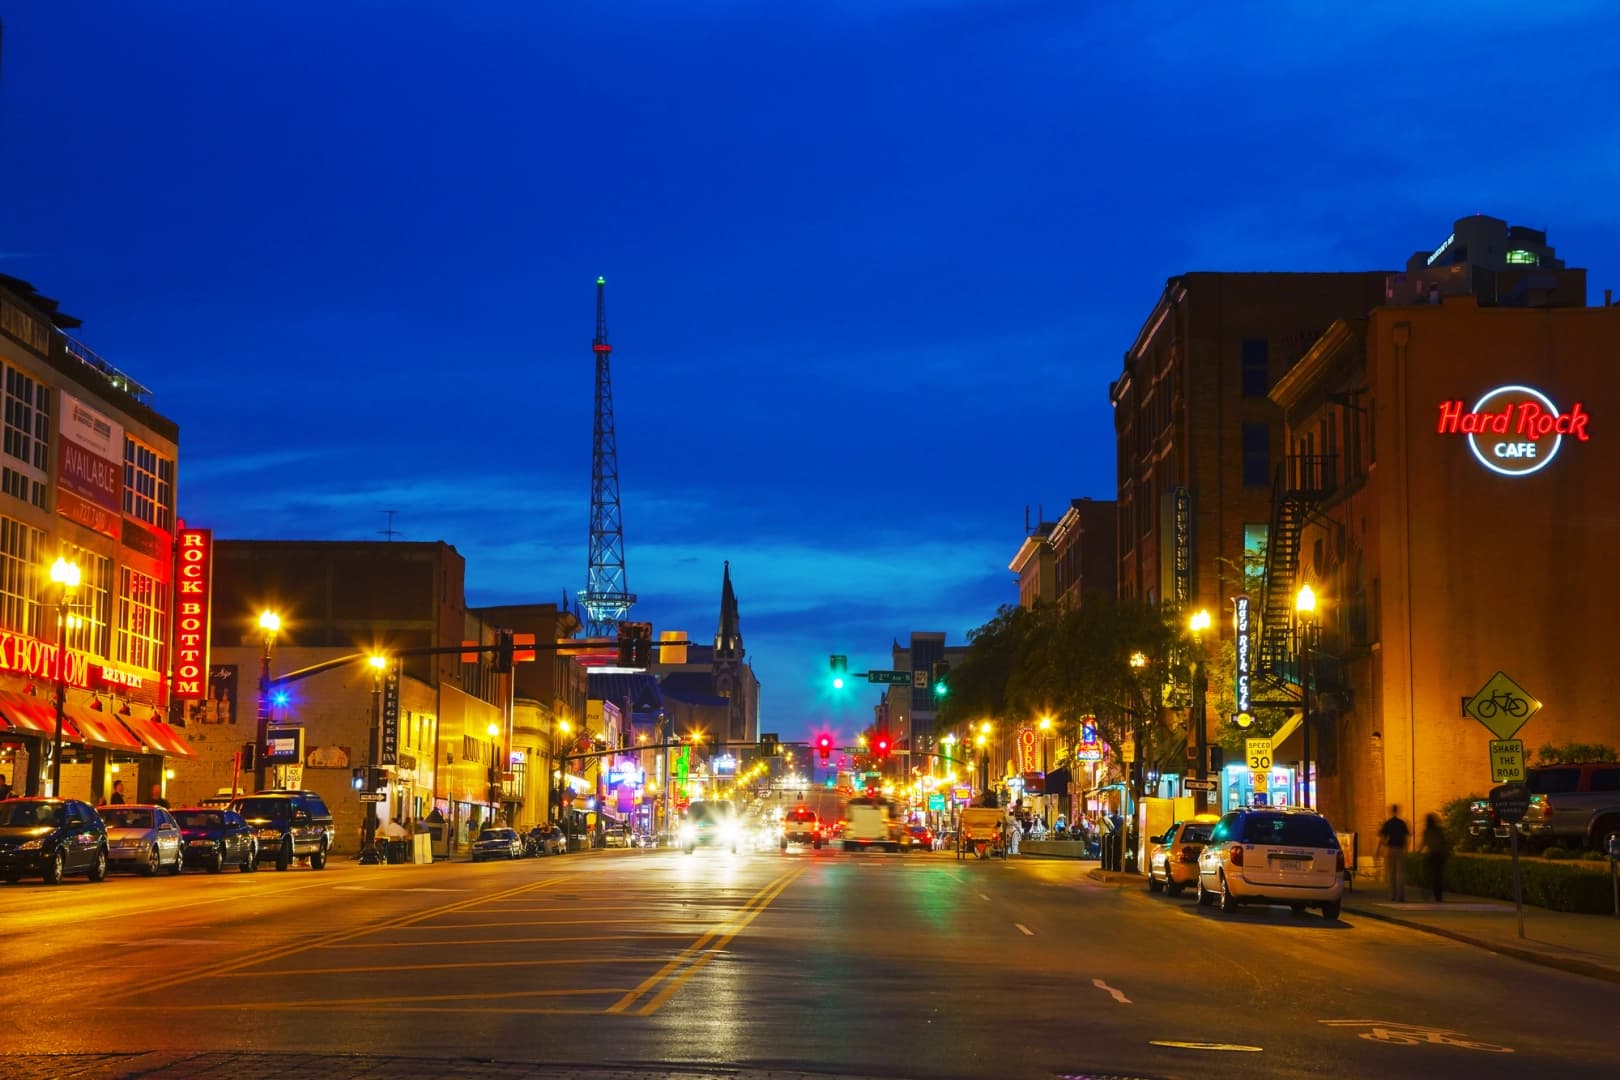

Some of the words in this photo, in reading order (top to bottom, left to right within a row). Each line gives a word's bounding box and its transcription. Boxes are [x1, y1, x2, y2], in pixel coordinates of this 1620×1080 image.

[1438, 400, 1514, 434] Hard
[1516, 401, 1589, 441] Rock
[1494, 442, 1536, 458] CAFE
[65, 446, 115, 494] AVAILABLE
[182, 534, 204, 593] ROCK
[1238, 599, 1248, 631] Hard
[12, 636, 88, 687] BOTTOM
[178, 603, 201, 693] BOTTOM
[1239, 635, 1249, 672] Rock
[102, 666, 142, 688] BREWERY
[1250, 756, 1270, 769] 30
[1493, 744, 1520, 753] SHARE
[1500, 756, 1516, 765] THE
[1497, 768, 1520, 777] ROAD
